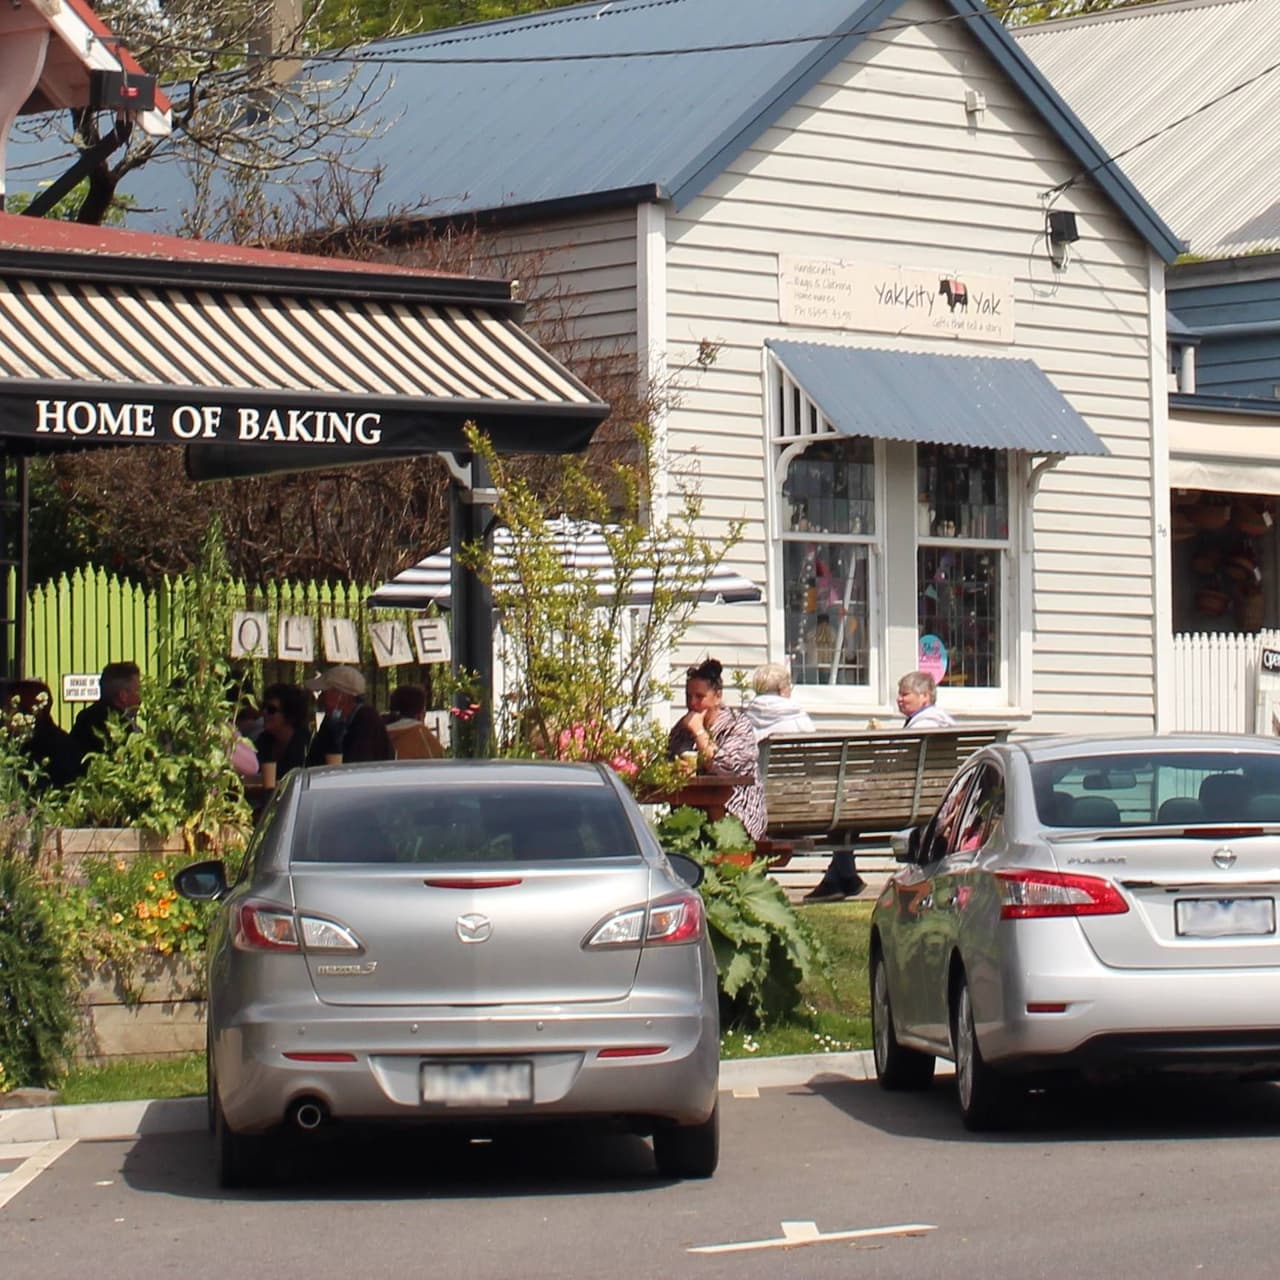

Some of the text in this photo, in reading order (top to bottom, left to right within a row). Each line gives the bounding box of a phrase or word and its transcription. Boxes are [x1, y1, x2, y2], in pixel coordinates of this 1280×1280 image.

[874, 282, 1001, 317] Yakkity Yak
[35, 400, 382, 444] HOME OF BAKING
[238, 617, 442, 657] OLIVE
[1067, 856, 1127, 865] PULSAR
